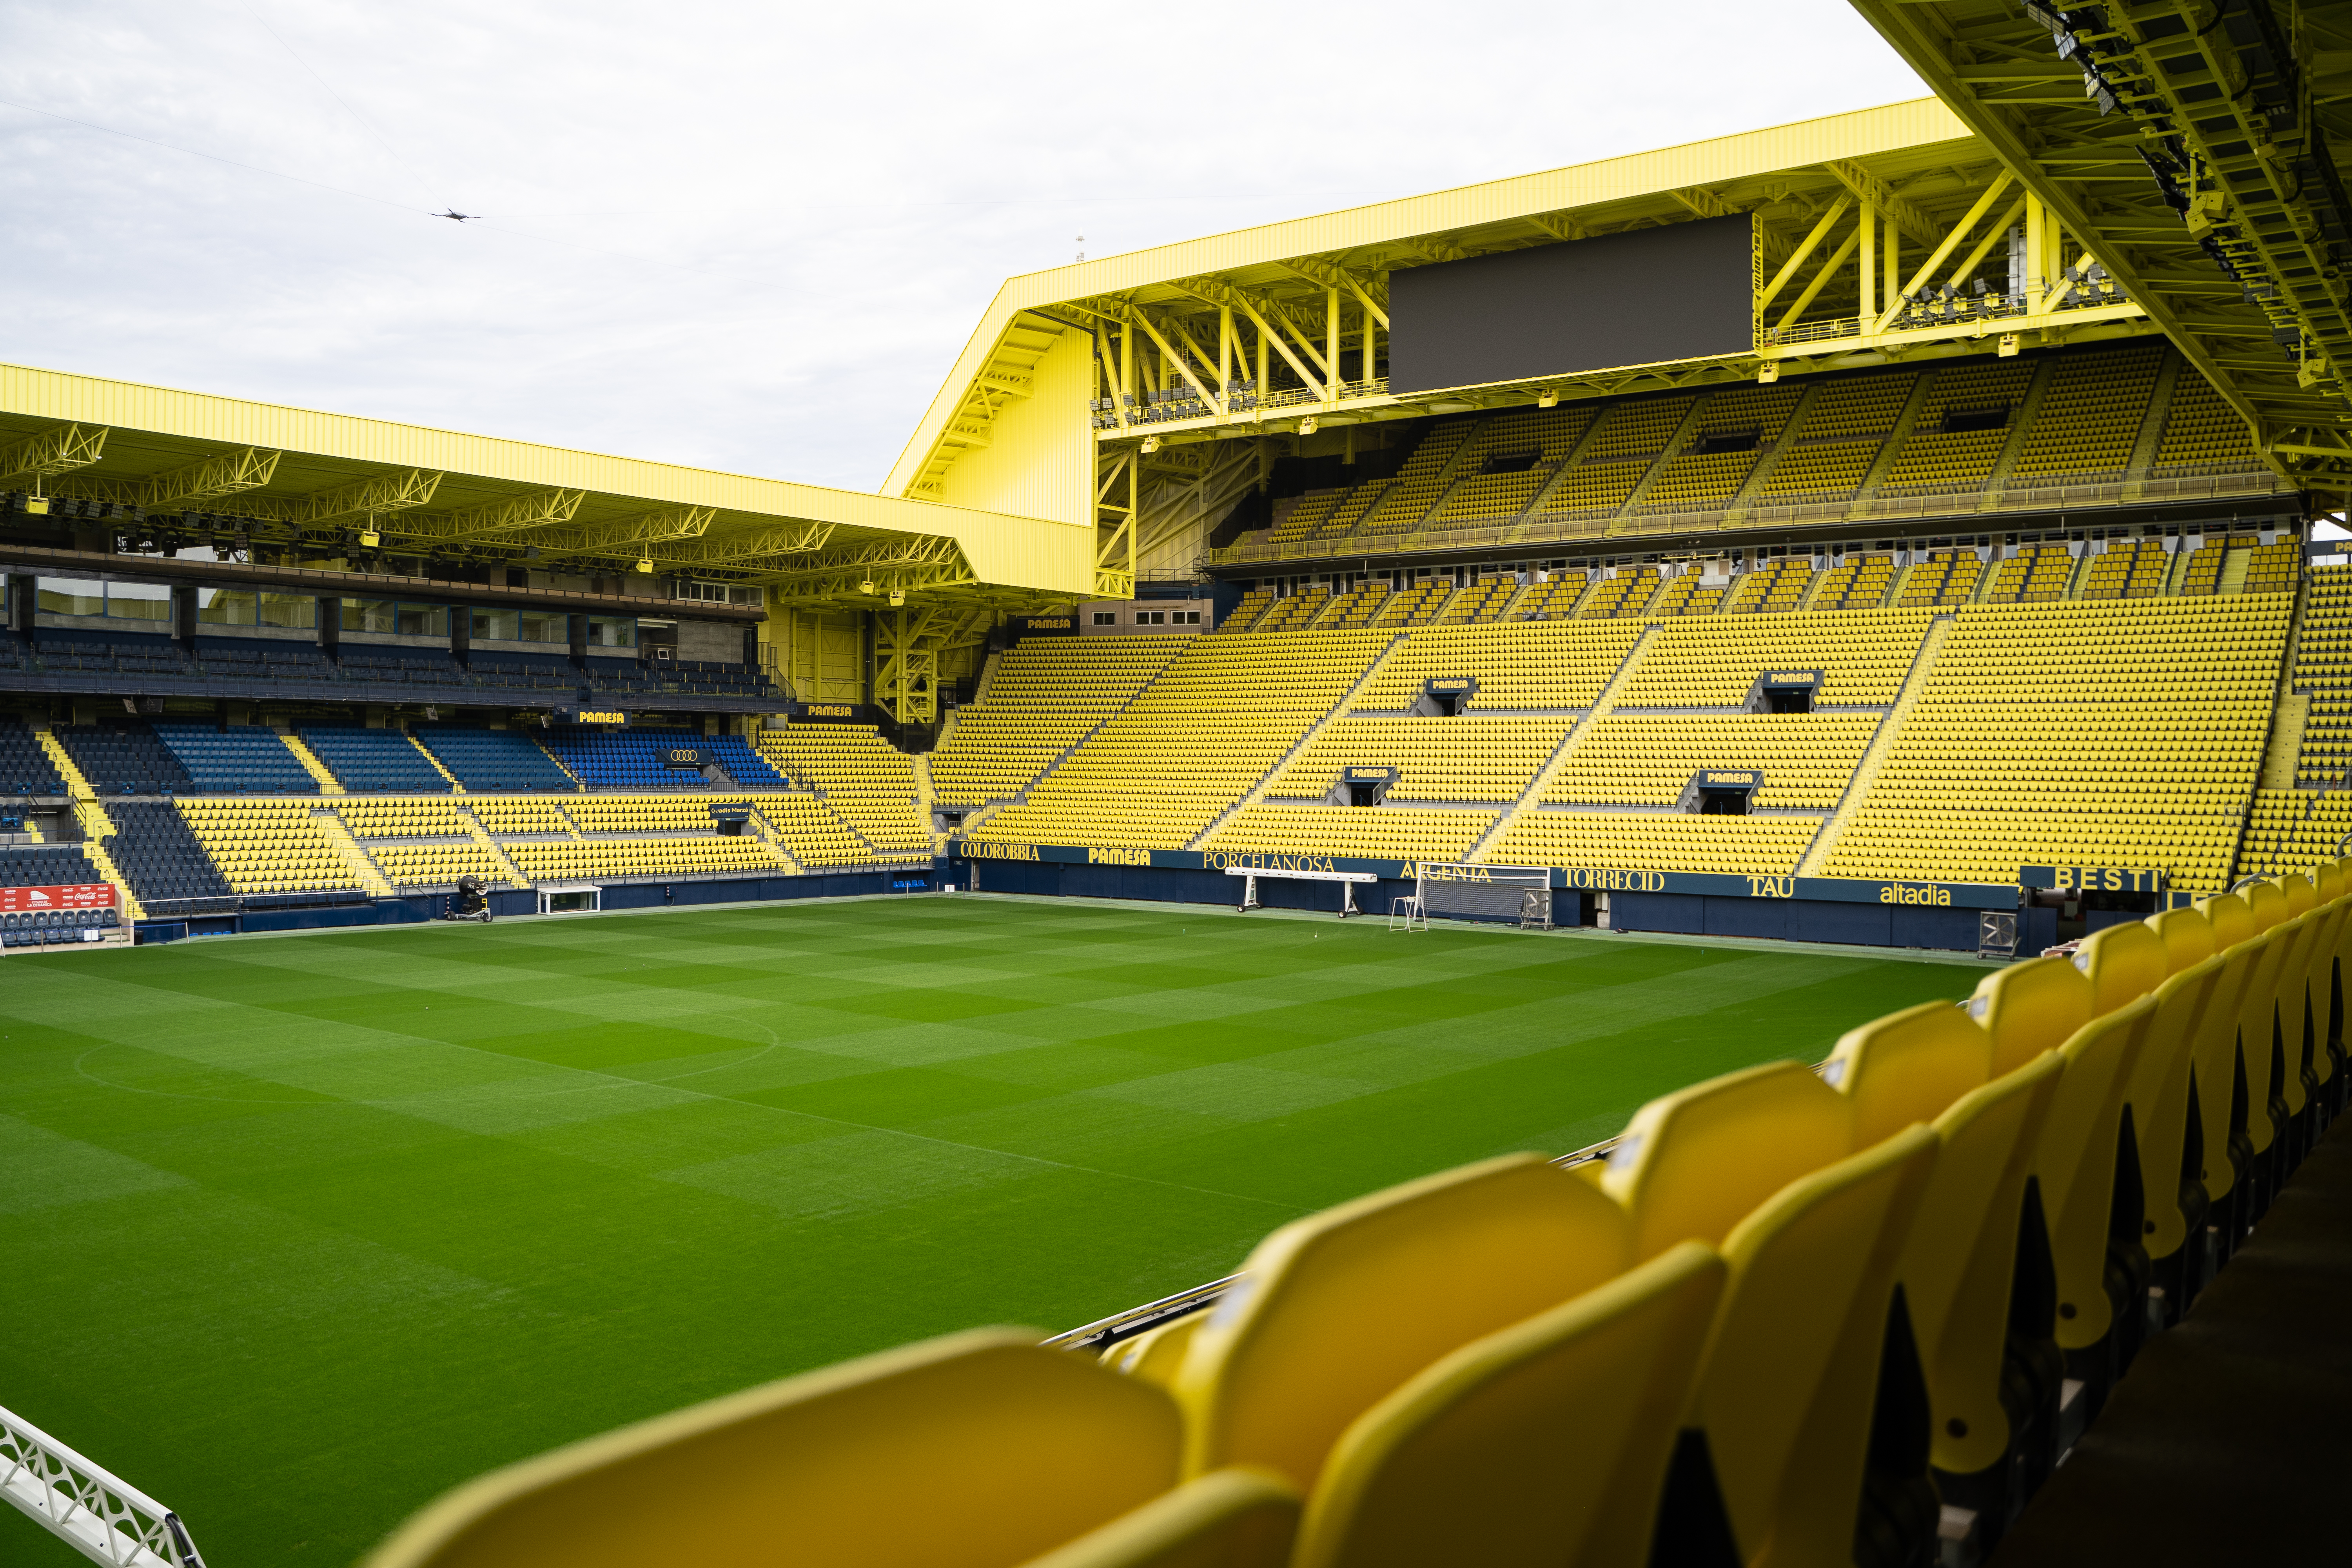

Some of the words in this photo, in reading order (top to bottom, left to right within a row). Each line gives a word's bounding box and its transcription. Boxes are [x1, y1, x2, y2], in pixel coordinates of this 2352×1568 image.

[1028, 619, 1071, 628] PAMESA
[1771, 673, 1814, 683] PAMESA
[1433, 680, 1468, 689] PAMESA
[808, 706, 852, 716] PAMESA
[580, 711, 624, 723] PAMESA
[1352, 769, 1388, 778] PAMESA
[1707, 772, 1753, 783] PAMESA
[960, 842, 1040, 861] COLOROBBIA
[1089, 848, 1151, 866] PAMESA
[1562, 868, 1665, 891] TORRECID
[1746, 876, 1796, 898] TAU
[1880, 882, 1951, 906] altadia
